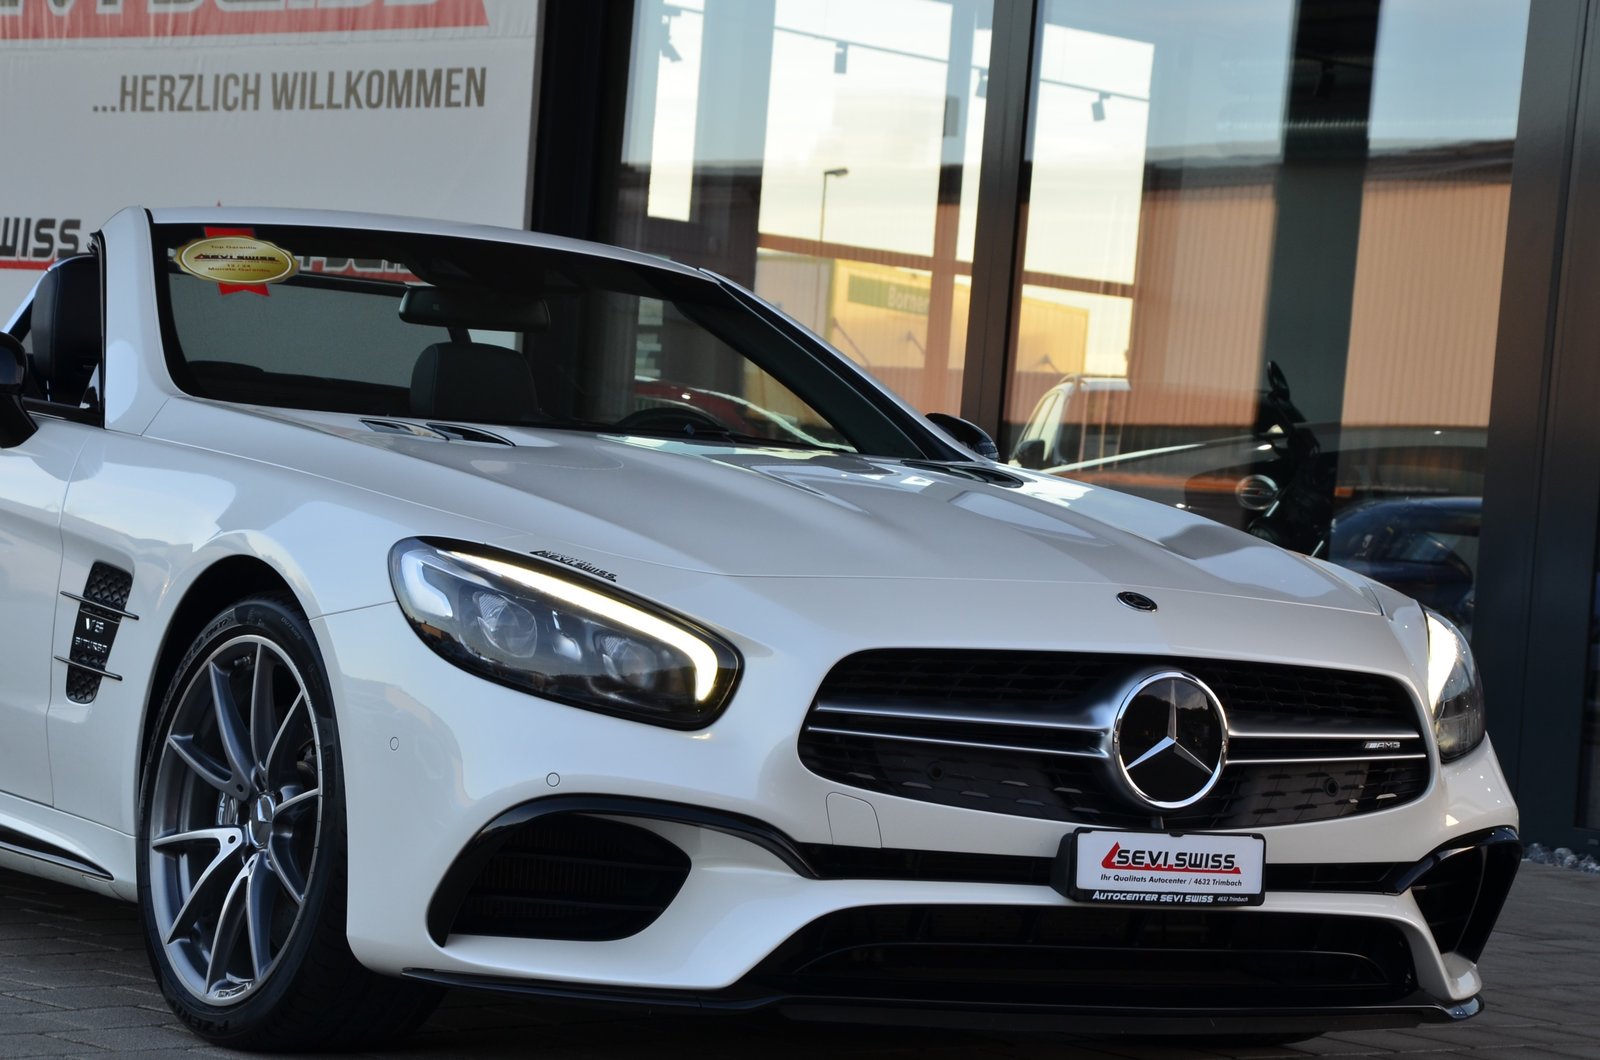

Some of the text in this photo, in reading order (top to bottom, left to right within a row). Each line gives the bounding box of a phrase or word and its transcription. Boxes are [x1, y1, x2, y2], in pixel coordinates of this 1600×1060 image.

[271, 67, 487, 111] WILLKOMMEN
[1116, 849, 1236, 870] SEVI SWISS
[1148, 876, 1187, 884] Autocenter
[1193, 878, 1211, 886] 4632
[1212, 878, 1242, 887] Trimbach
[1159, 894, 1184, 902] SEVI
[1184, 895, 1214, 903] SWISS
